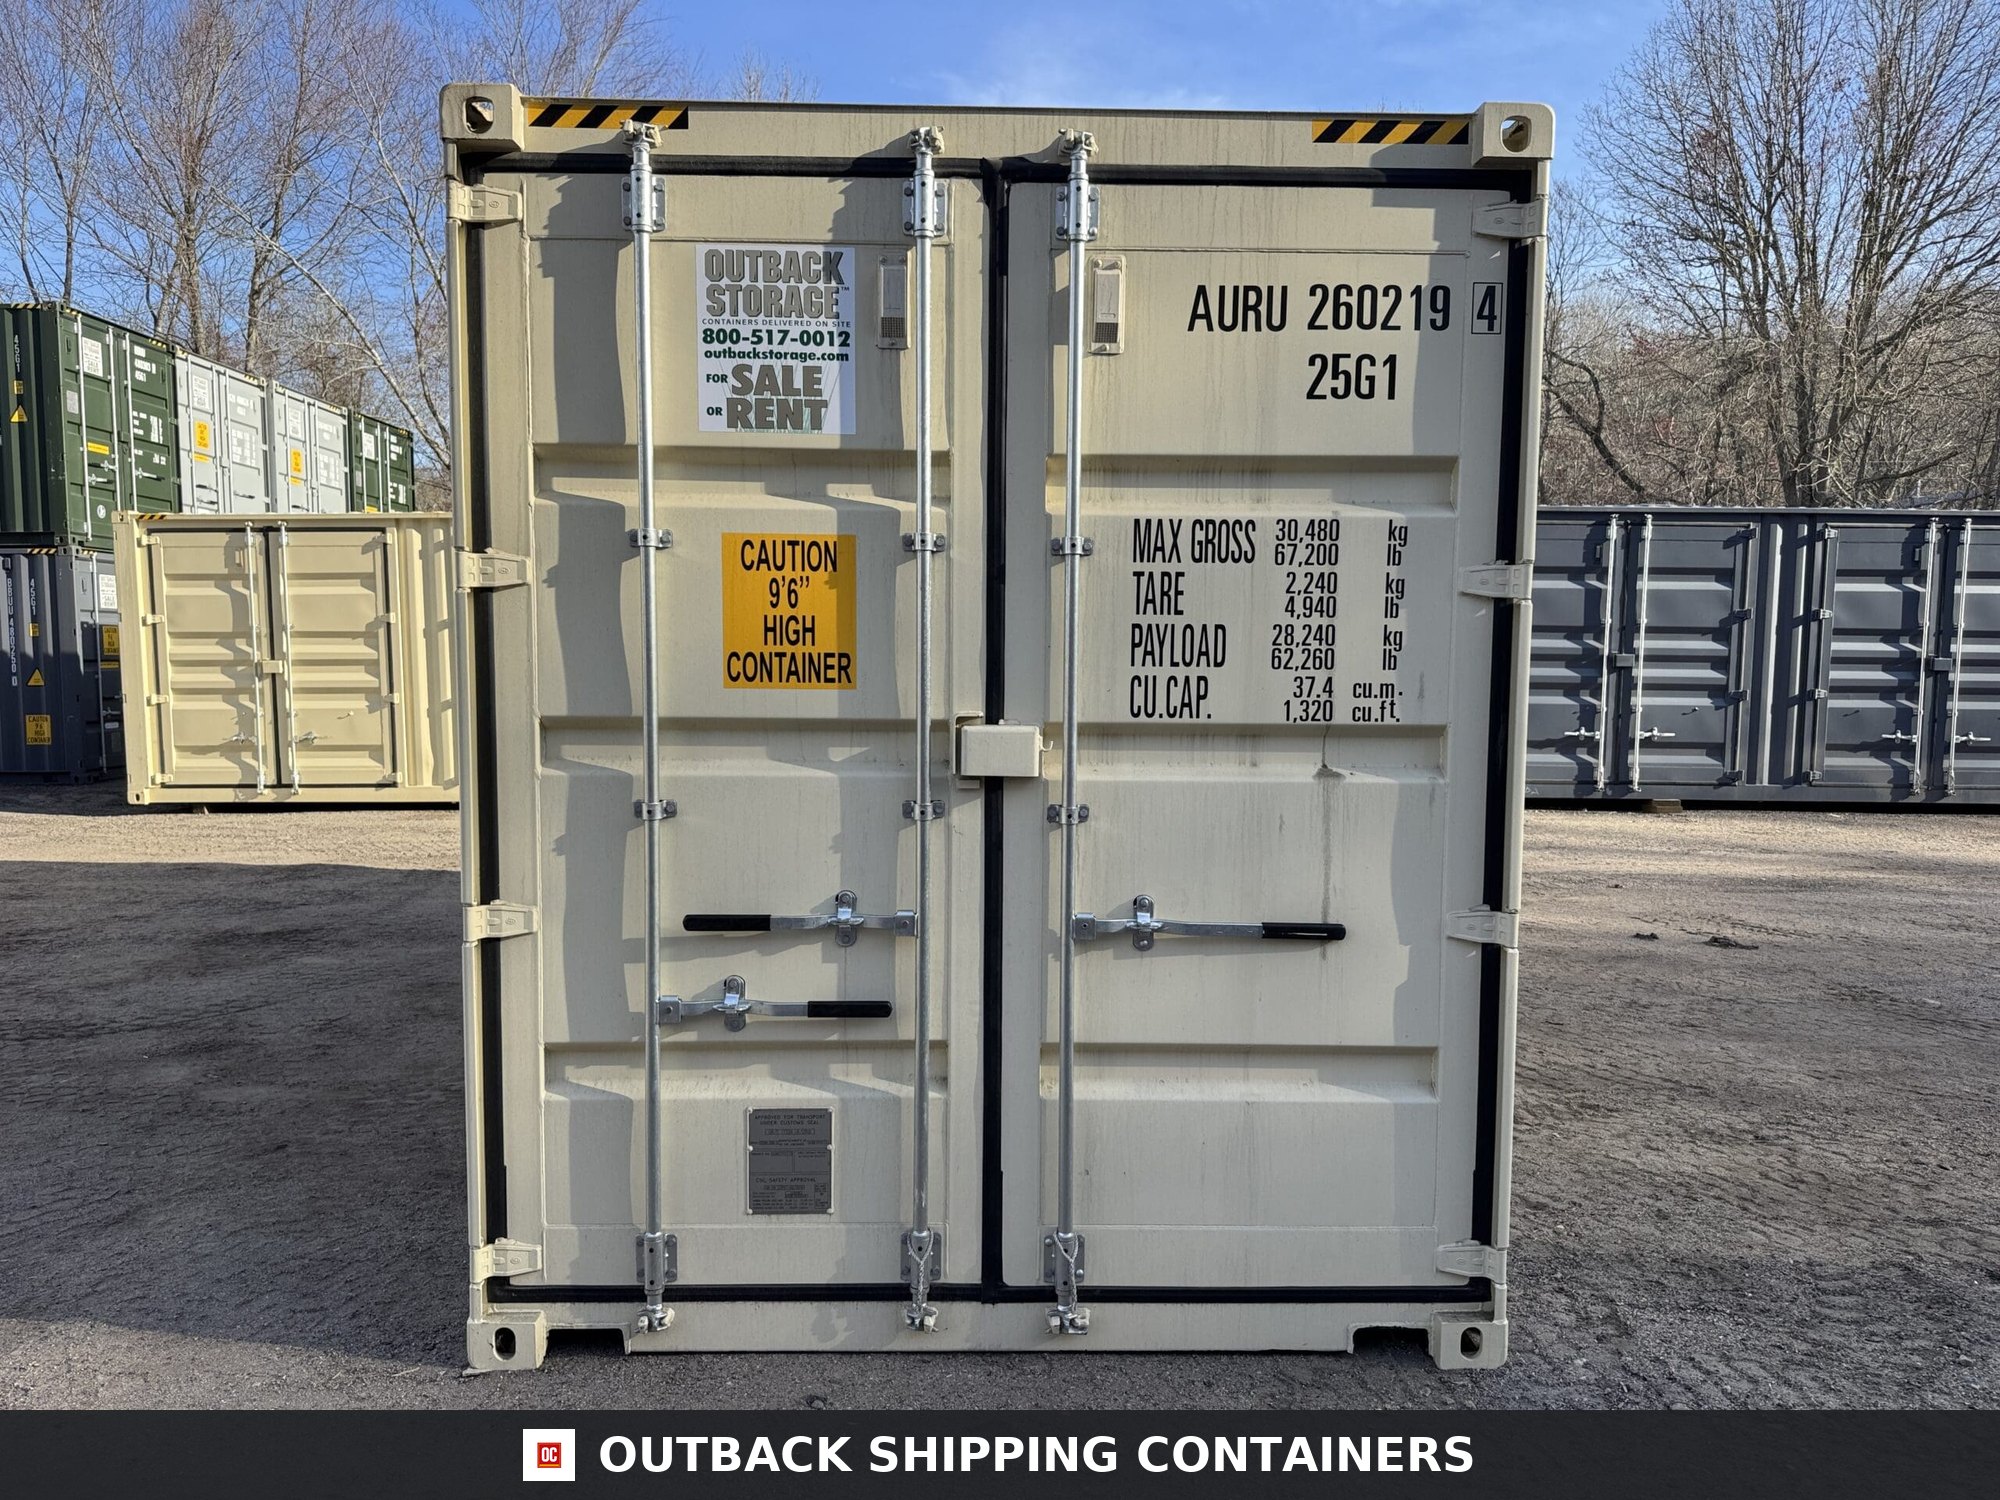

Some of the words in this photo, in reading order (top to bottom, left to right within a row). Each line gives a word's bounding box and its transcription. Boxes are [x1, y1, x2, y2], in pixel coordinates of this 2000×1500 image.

[705, 248, 845, 284] OUTBACK
[1188, 285, 1287, 332] AURU
[1308, 284, 1450, 331] 260219
[1477, 286, 1497, 331] 4
[703, 329, 850, 347] 800-517-0012
[705, 347, 849, 362] outbackstorage.com
[707, 374, 727, 383] FOR
[732, 364, 822, 396] SALE
[1307, 354, 1396, 400] 25G1
[707, 407, 722, 415] OR
[727, 397, 828, 430] RENT
[741, 540, 837, 572] CAUTION
[1133, 519, 1182, 563] MAX
[1191, 519, 1255, 563] GROSS
[1276, 519, 1339, 543] 30,480
[1388, 520, 1408, 547] kg
[1275, 542, 1338, 567] 67,200
[1387, 543, 1402, 566] lb
[1133, 572, 1185, 615] TARE
[1286, 572, 1337, 595] 2,240
[1385, 572, 1405, 599] kg
[1285, 596, 1336, 619] 4,940
[1384, 597, 1399, 619] lb
[764, 615, 815, 646] HIGH
[1131, 623, 1226, 667] PAYLOAD
[1272, 624, 1335, 647] 28,240
[1383, 625, 1403, 652] kg
[727, 652, 852, 683] CONTAINER
[1272, 648, 1334, 671] 62,260
[1382, 649, 1397, 671] lb
[1130, 675, 1211, 718] CU.CAP.
[1294, 677, 1333, 698] 37.4
[1353, 683, 1402, 698] cu.m.
[1284, 700, 1333, 723] 1,320
[1353, 700, 1399, 722] cu.ft.
